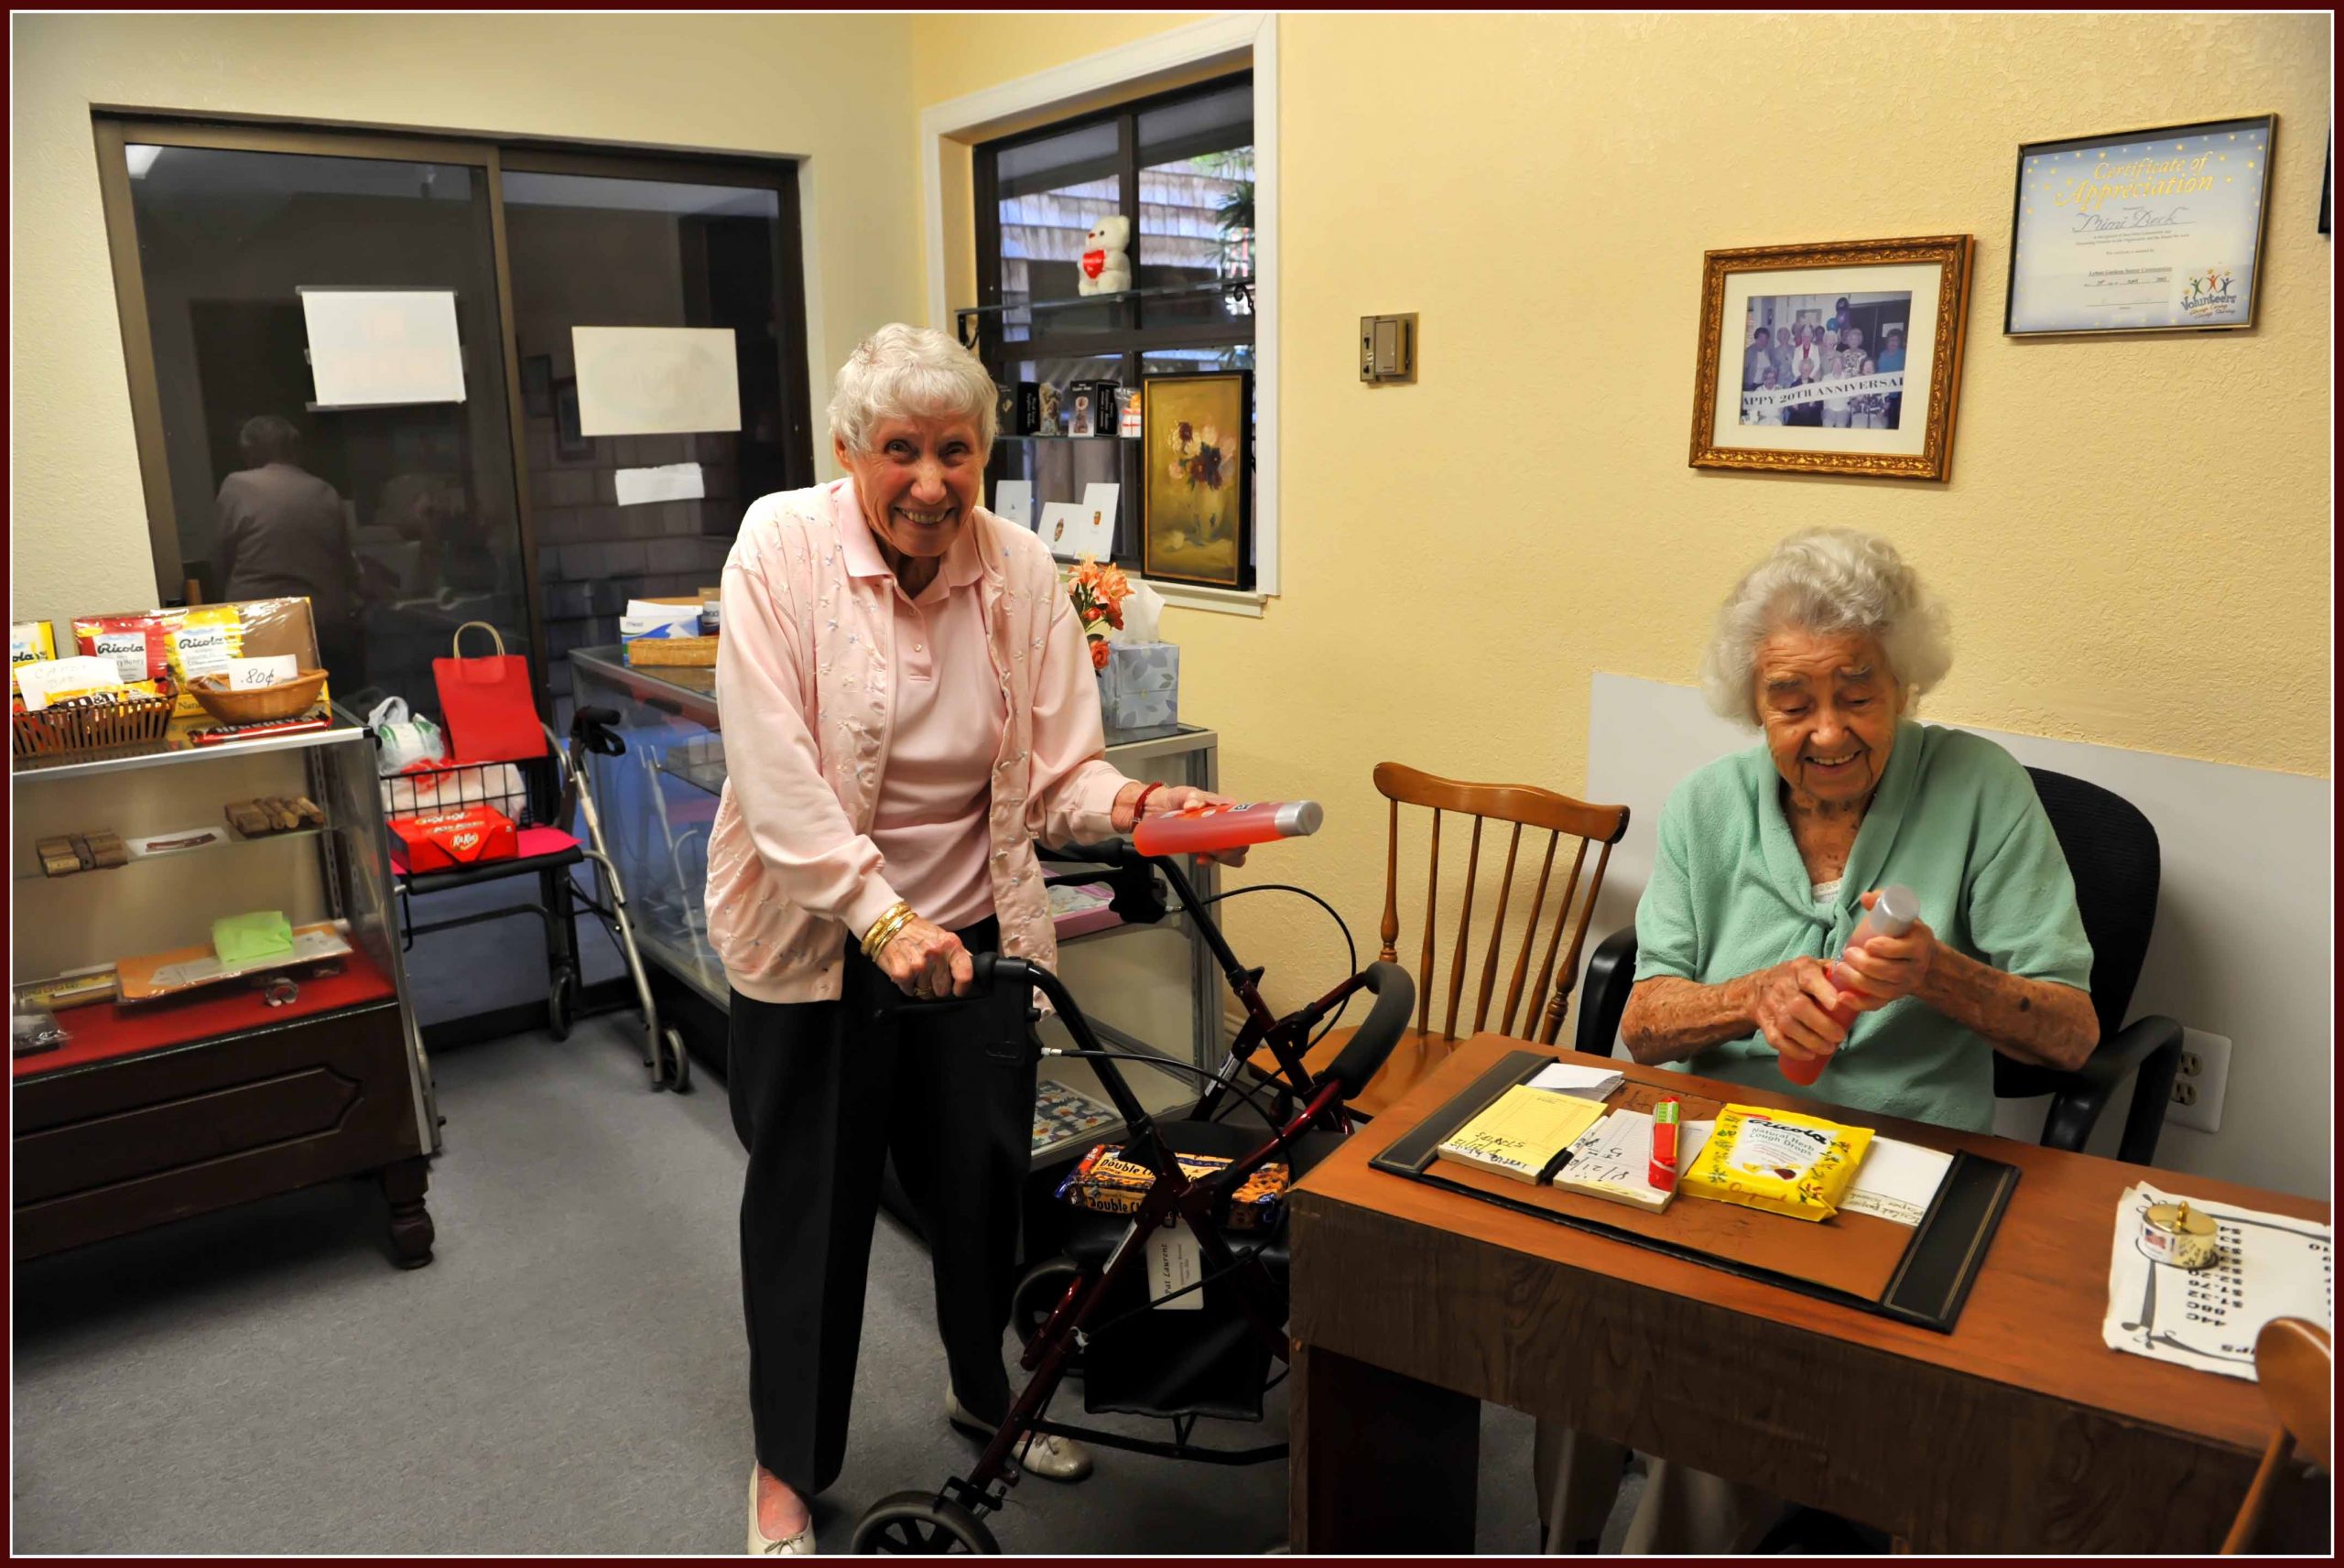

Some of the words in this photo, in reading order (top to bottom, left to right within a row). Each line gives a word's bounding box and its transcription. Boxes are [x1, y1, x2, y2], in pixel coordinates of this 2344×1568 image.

[2094, 157, 2187, 181] Certificate
[2189, 151, 2214, 174] of
[2054, 172, 2214, 212] Appreciation
[2180, 292, 2237, 311] Volunteers
[1780, 389, 1812, 404] 20TH
[96, 643, 145, 654] Ricola
[1748, 1119, 1828, 1145] Ricola
[1752, 1127, 1789, 1140] Natural
[1791, 1137, 1815, 1152] Herb
[1749, 1132, 1781, 1143] Cough
[1783, 1140, 1812, 1156] Drops
[1100, 1159, 1140, 1174] Double
[1088, 1196, 1129, 1213] Double
[2187, 1269, 2243, 1286] $2.20
[2187, 1280, 2243, 1297] $1.76
[2187, 1290, 2244, 1309] $1.32
[2185, 1301, 2227, 1316] 88C
[2185, 1312, 2227, 1328] 44C
